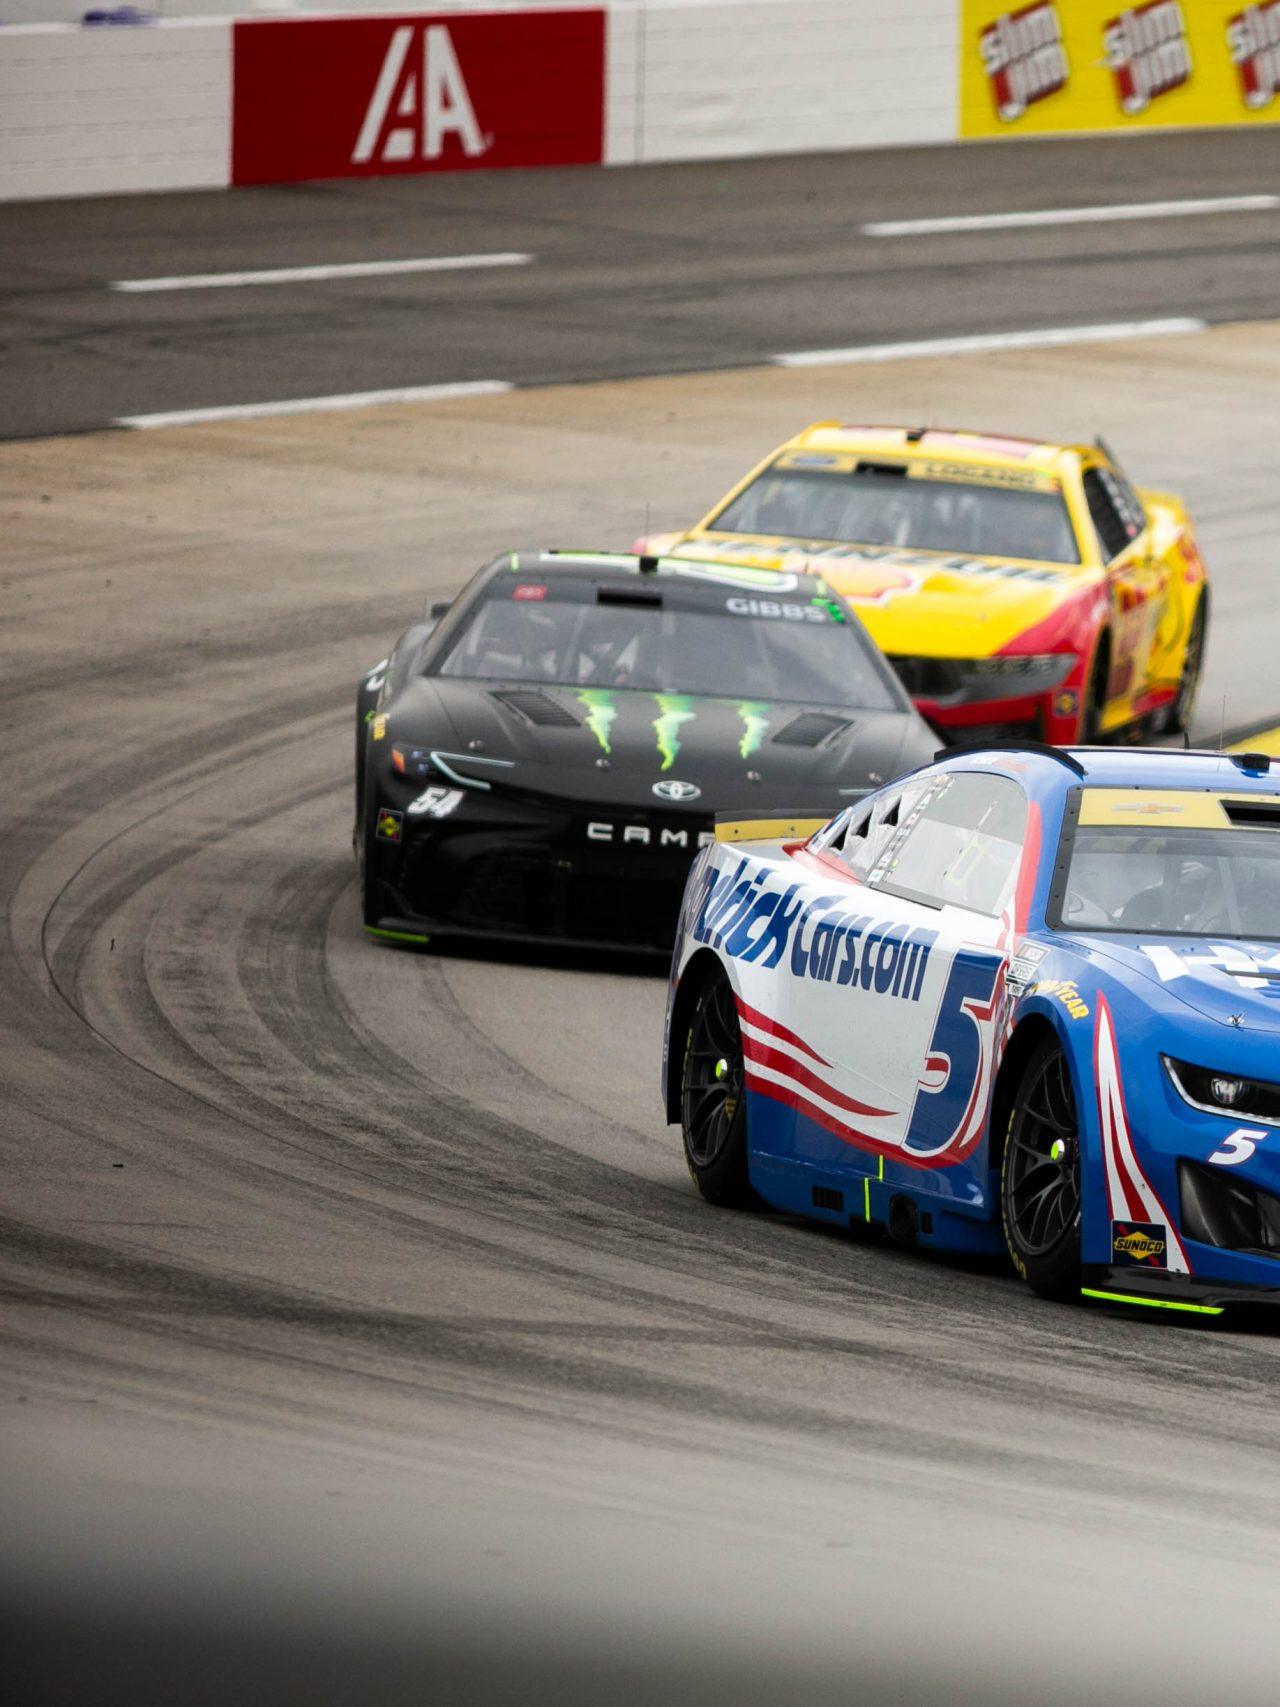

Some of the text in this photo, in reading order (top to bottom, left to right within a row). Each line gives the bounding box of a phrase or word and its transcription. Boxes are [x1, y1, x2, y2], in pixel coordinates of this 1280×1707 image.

[726, 597, 827, 623] GIBBS
[407, 786, 464, 818] 54
[904, 948, 1005, 1153] 5
[1208, 1128, 1271, 1166] 5
[1115, 1237, 1164, 1252] SUNOCO
